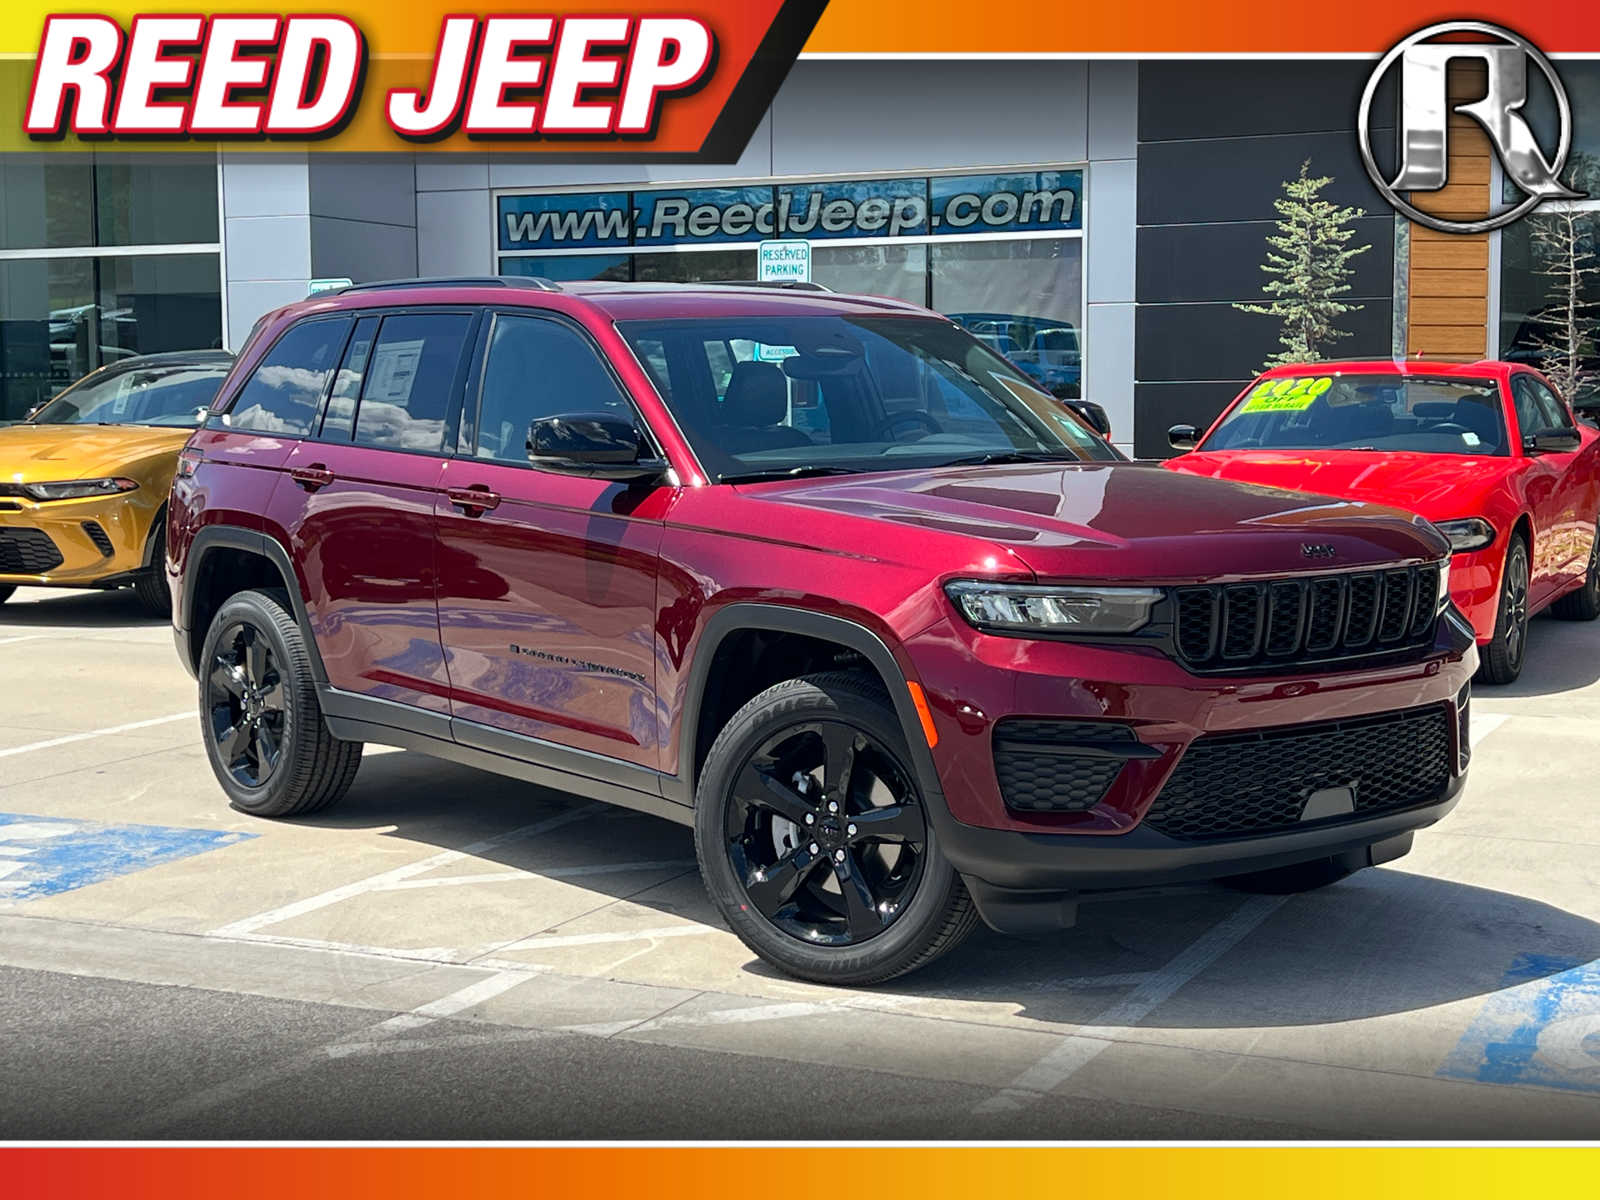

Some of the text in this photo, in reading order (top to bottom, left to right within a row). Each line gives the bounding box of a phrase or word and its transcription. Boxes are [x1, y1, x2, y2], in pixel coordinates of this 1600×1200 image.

[505, 188, 1077, 244] www.ReedJeep.com
[763, 249, 807, 261] RESERVED
[765, 263, 804, 276] PARKING
